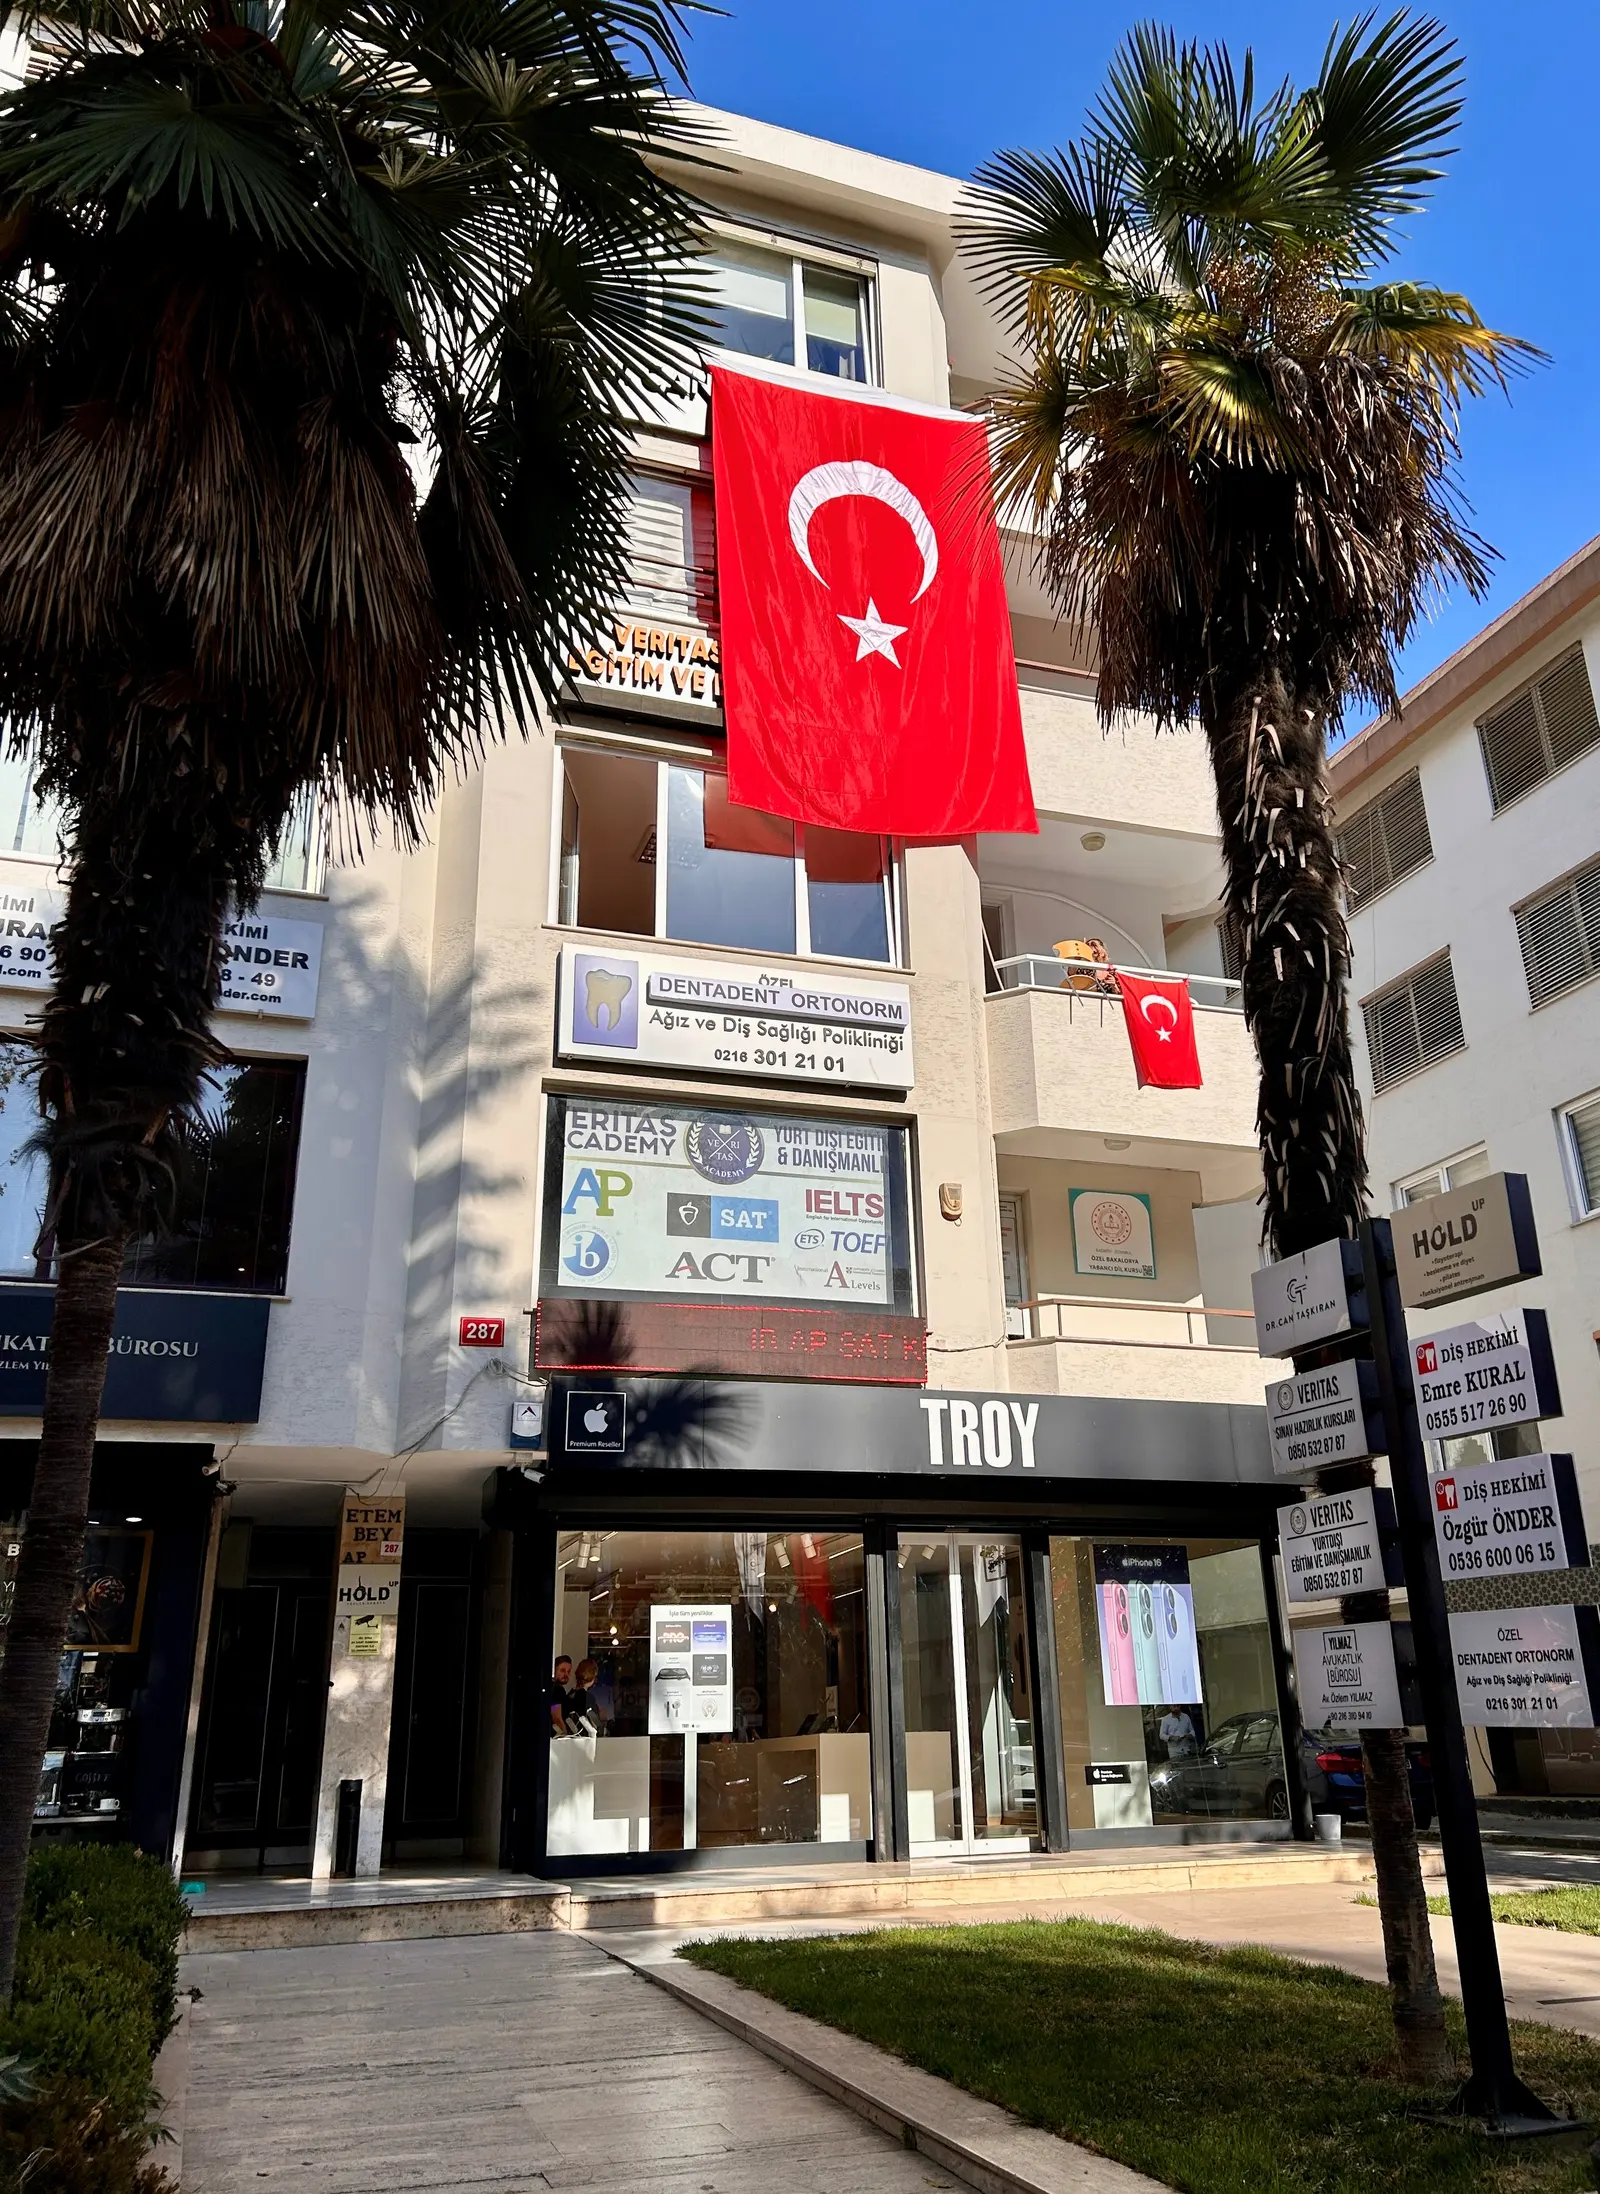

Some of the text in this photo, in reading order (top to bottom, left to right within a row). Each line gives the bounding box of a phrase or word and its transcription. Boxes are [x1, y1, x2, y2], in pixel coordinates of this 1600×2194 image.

[672, 666, 705, 694] VE
[0, 895, 35, 913] İMİ
[219, 922, 268, 940] KİMİ
[20, 947, 46, 962] 90
[222, 940, 309, 970] NDER
[251, 973, 276, 987] 49
[659, 977, 903, 1020] DENTADENT ORTONORM
[649, 1010, 904, 1053] Ağız ve Diş Sağlığı Polikliniği
[714, 1049, 845, 1073] 0216 301 21 01
[570, 1106, 677, 1137] ERITAS
[566, 1130, 676, 1156] CADEMY
[774, 1125, 811, 1145] YURT
[716, 1152, 733, 1161] TAS
[778, 1147, 788, 1166] &
[703, 1166, 746, 1178] ACADEMY
[562, 1168, 633, 1217] AP
[806, 1189, 884, 1219] IELTS
[720, 1209, 767, 1229] SAT
[1412, 1198, 1485, 1258] HOLD UP
[800, 1234, 819, 1244] ETS
[665, 1251, 771, 1283] ACT
[1089, 1264, 1113, 1272] YABANCI
[1106, 1256, 1139, 1264] BAKALORYA
[1460, 1256, 1475, 1266] diyet
[824, 1261, 850, 1289] A
[851, 1280, 881, 1291] Levels
[1441, 1271, 1460, 1283] pilates
[1296, 1299, 1336, 1319] TAŞKIRAN
[466, 1323, 499, 1339] 287
[0, 1334, 50, 1351] KAT
[839, 1332, 894, 1359] SAT
[1441, 1325, 1519, 1363] DİŞ HEKİMİ
[1297, 1375, 1339, 1404] VERITAS
[1420, 1360, 1526, 1403] Emre KURAL
[1426, 1392, 1527, 1430] 0555 517 26 90
[920, 1398, 1040, 1468] TROY
[1275, 1408, 1356, 1440] SINAV HAZIRLIK KURSLARI
[570, 1440, 596, 1448] Premium
[1288, 1434, 1345, 1460] 0850 532 87 87
[1463, 1468, 1547, 1503] DİŞ HEKİMİ
[346, 1508, 402, 1523] ETEM
[1310, 1499, 1354, 1528] VERITAS
[353, 1527, 393, 1541] BEY
[1443, 1505, 1556, 1545] Özgür ÖNDER
[7, 1543, 20, 1556] B
[384, 1544, 399, 1553] 287
[1312, 1532, 1343, 1552] YURTDIŞI
[342, 1552, 366, 1564] AP
[1128, 1558, 1162, 1567] iPhone 16
[1291, 1544, 1371, 1573] EĞİTİM VE DANIŞMANLIK
[1448, 1541, 1555, 1571] 0536 600 06 15
[1303, 1567, 1363, 1592] 0850 532 87 87
[339, 1587, 390, 1602] HOLD
[1328, 1636, 1352, 1650] YILMAZ
[1497, 1628, 1523, 1641] ÖZEL
[1322, 1653, 1363, 1666] AVUKATLIK
[1457, 1648, 1575, 1666] DENTADENT ORTONORM
[1330, 1667, 1358, 1682] BÜROSU
[1466, 1672, 1573, 1687] Ağız ve Diş Sağlığı Polikliniği
[1331, 1692, 1348, 1703] Özlem
[1350, 1692, 1373, 1702] YILMAZ
[1486, 1697, 1558, 1710] 0216 301 21 01
[1358, 1711, 1365, 1720] 94
